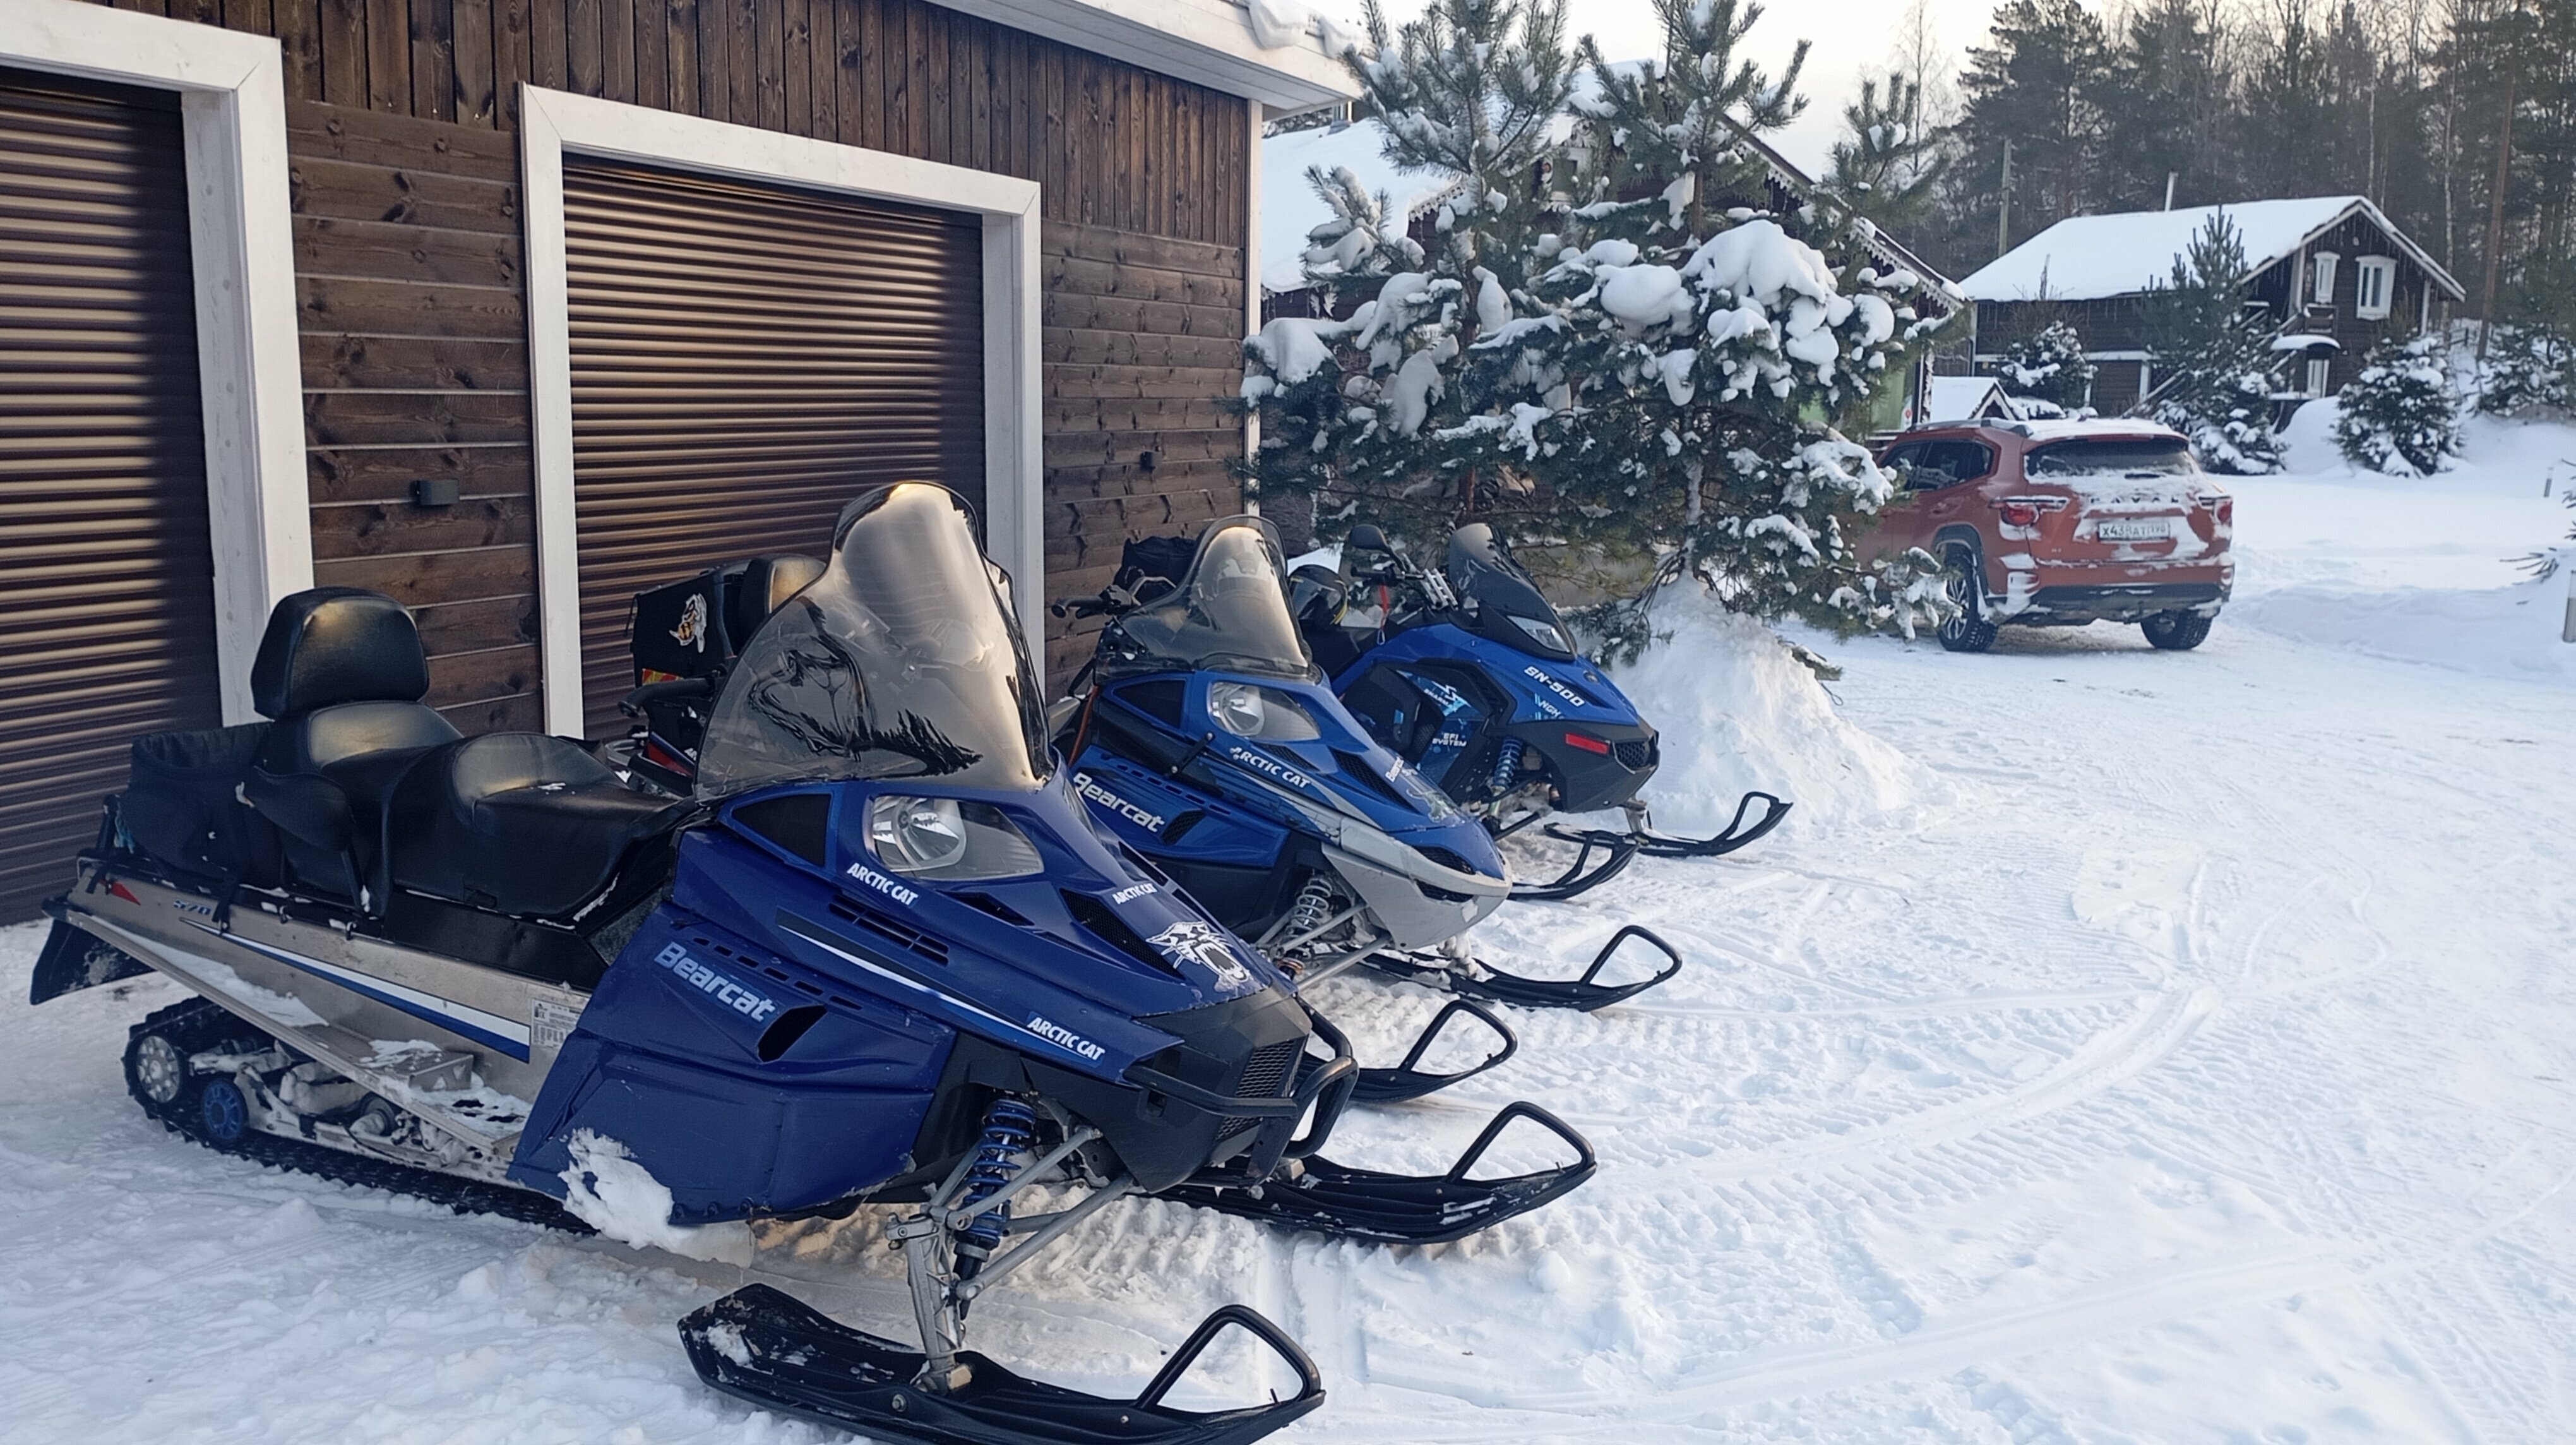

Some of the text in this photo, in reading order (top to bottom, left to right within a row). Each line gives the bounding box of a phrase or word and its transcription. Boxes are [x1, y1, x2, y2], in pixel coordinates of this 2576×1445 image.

[1524, 666, 1585, 707] SN-500
[1432, 738, 1467, 746] SYSTEM
[1282, 771, 1311, 788] CAT
[1073, 772, 1165, 832] Bearcat
[847, 862, 919, 906] ARCTIC CAT
[1112, 885, 1145, 905] ARCTIC
[654, 942, 776, 1022] Bearcat
[1027, 1017, 1106, 1060] ARCTIC CAT
